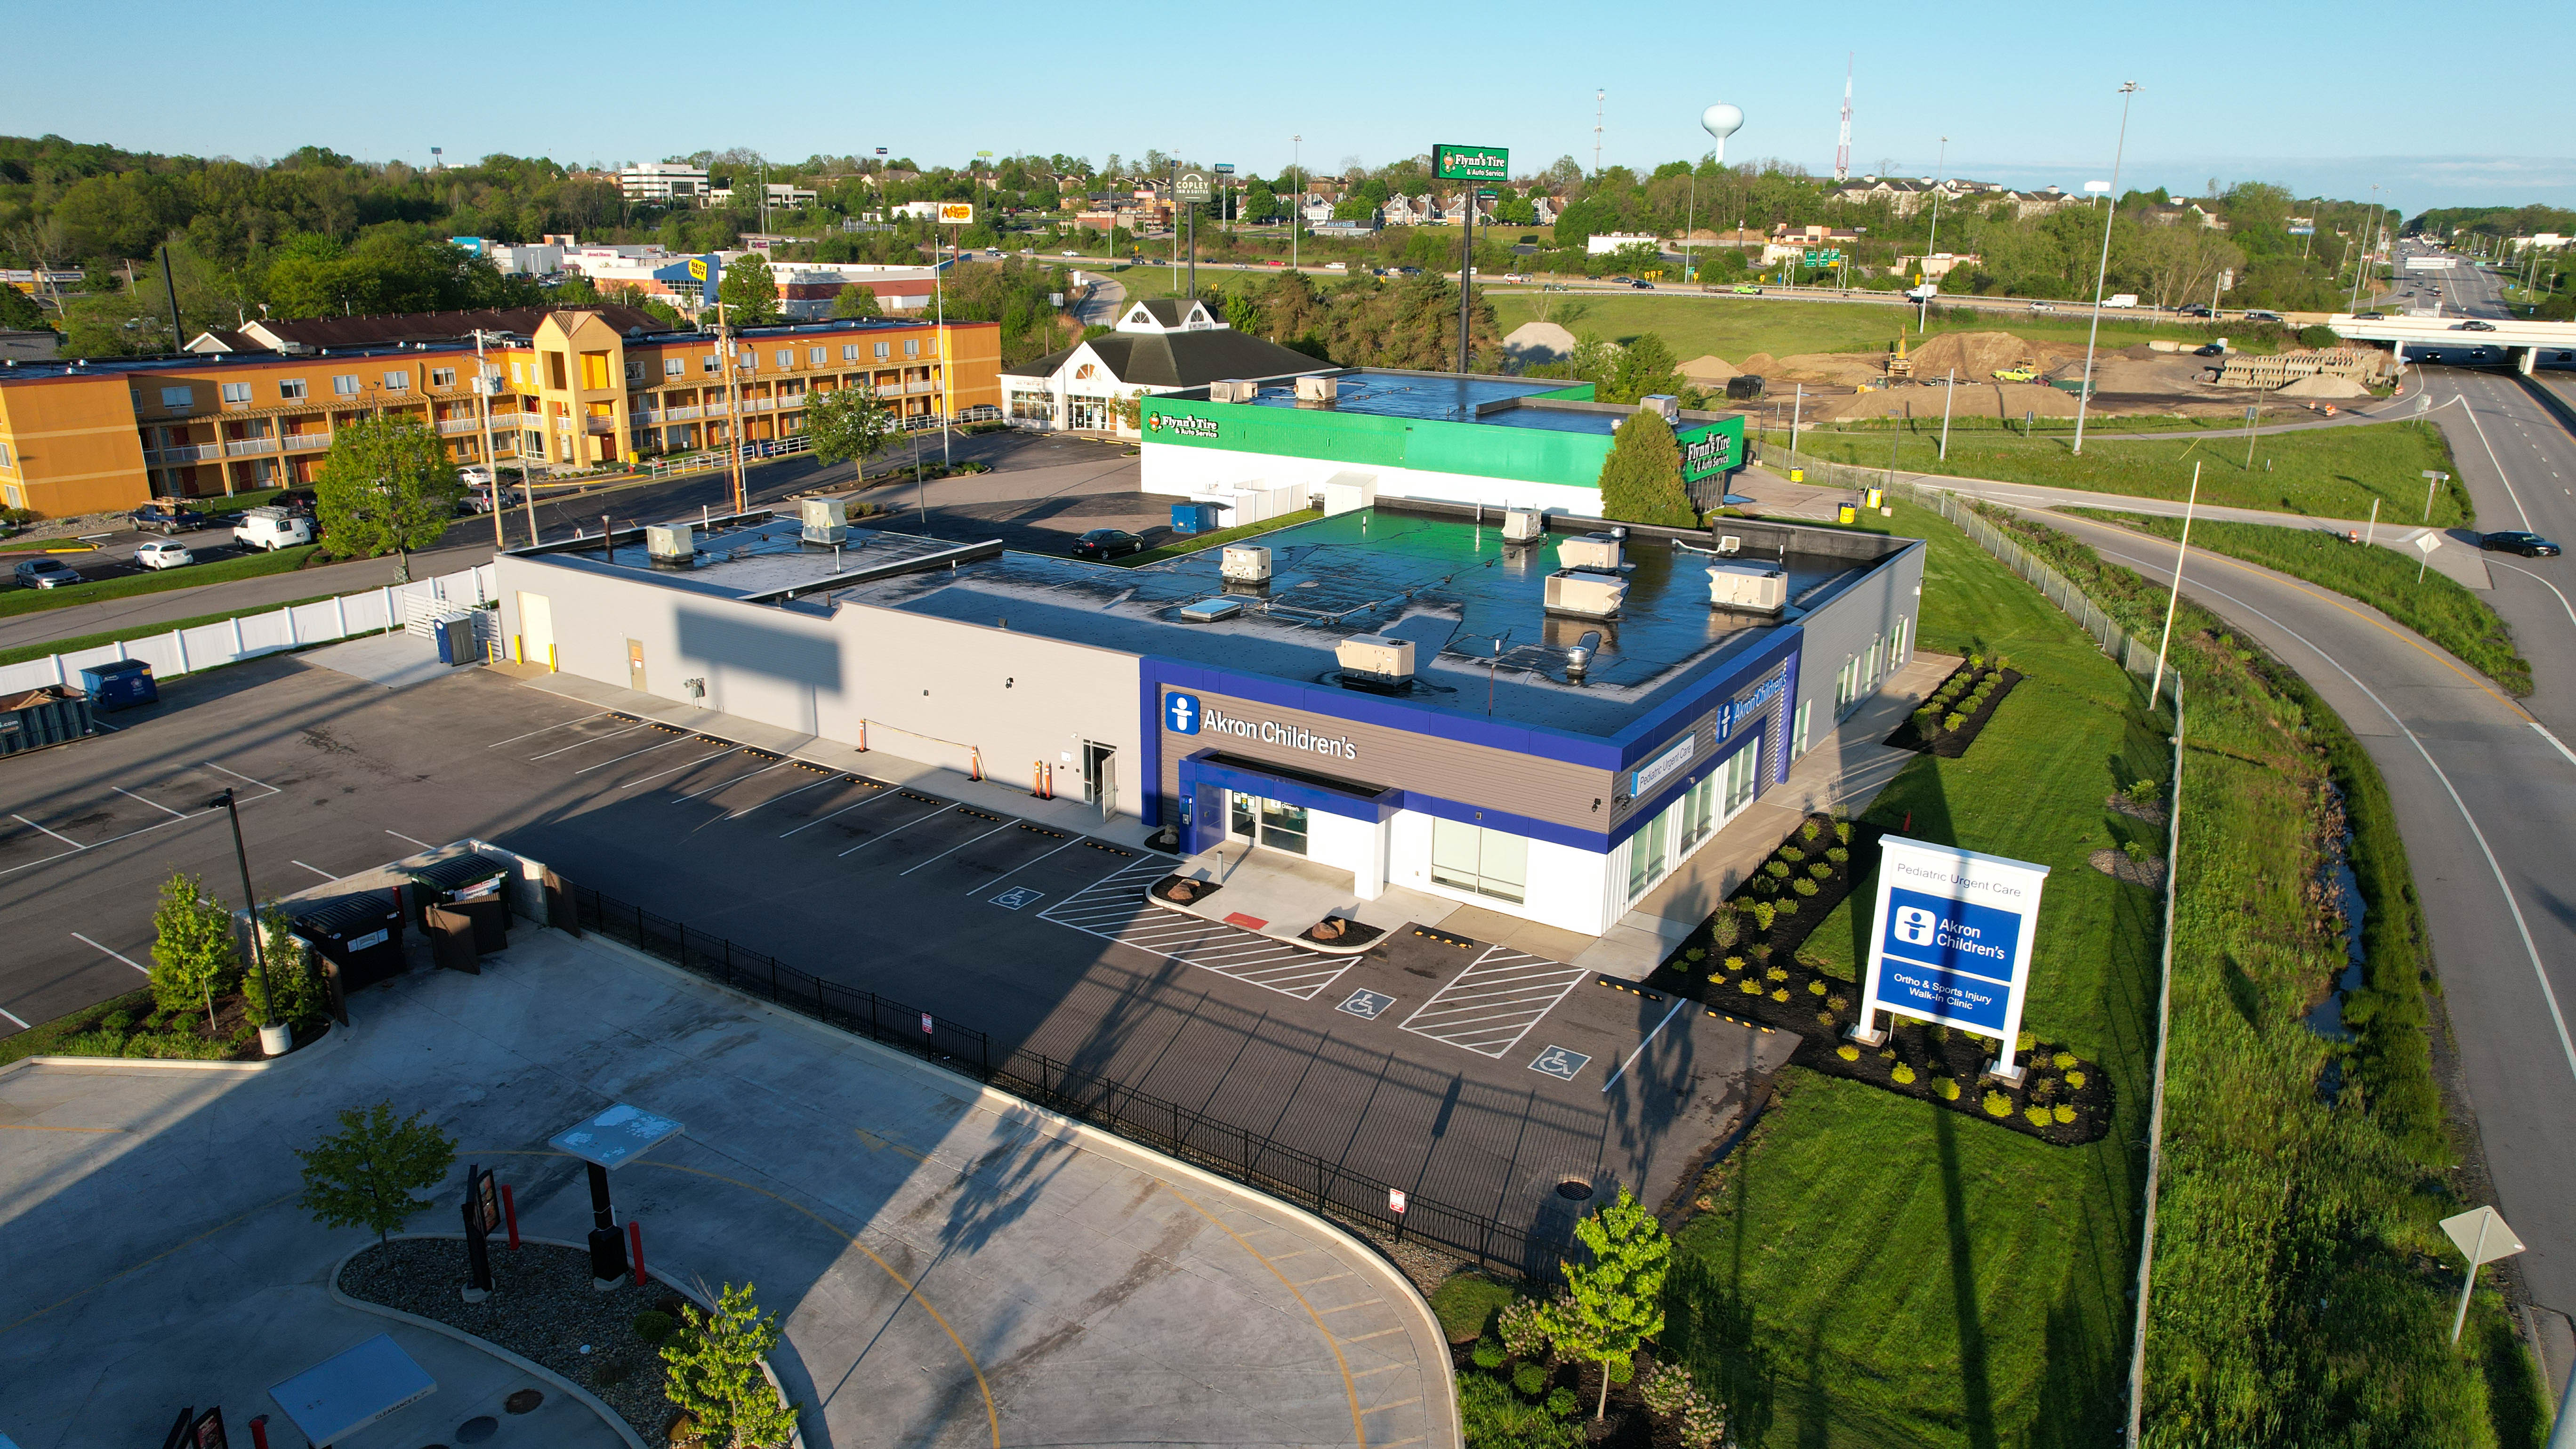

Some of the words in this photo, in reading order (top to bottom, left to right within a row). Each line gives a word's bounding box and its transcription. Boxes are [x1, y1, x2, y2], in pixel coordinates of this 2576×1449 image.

[1455, 152, 1486, 168] Flynn's
[1487, 155, 1505, 167] Tire
[692, 262, 705, 271] BEST
[692, 268, 704, 276] BUY
[1162, 415, 1196, 428] Flynn's
[1196, 419, 1217, 429] Tire
[1196, 429, 1217, 438] Service
[1687, 433, 1715, 463] Flynn's
[1716, 434, 1730, 452] Tire
[1697, 463, 1700, 472] &
[1701, 459, 1712, 471] Auto
[1713, 455, 1729, 467] Service
[1734, 697, 1755, 724] Akron
[1756, 671, 1787, 707] Children's
[1204, 709, 1257, 740] Akron
[1261, 721, 1357, 760] Children's
[1640, 764, 1662, 788] Pediatric
[1663, 753, 1679, 772] Urgent
[1680, 745, 1691, 760] Care
[1898, 863, 1947, 881] Pediatric
[1951, 874, 1989, 890] Urgent
[1993, 883, 2021, 897] Care
[1939, 918, 1981, 938] Akron
[1937, 934, 2005, 960] Children's
[1894, 973, 1920, 987] Ortho
[1922, 980, 1930, 989] &
[1932, 983, 1963, 997] Sports
[1965, 990, 1992, 1005] Injury
[1909, 987, 1944, 1002] Walk-In
[1947, 997, 1973, 1010] Clinic
[375, 1398, 412, 1420] CLEARANCE
